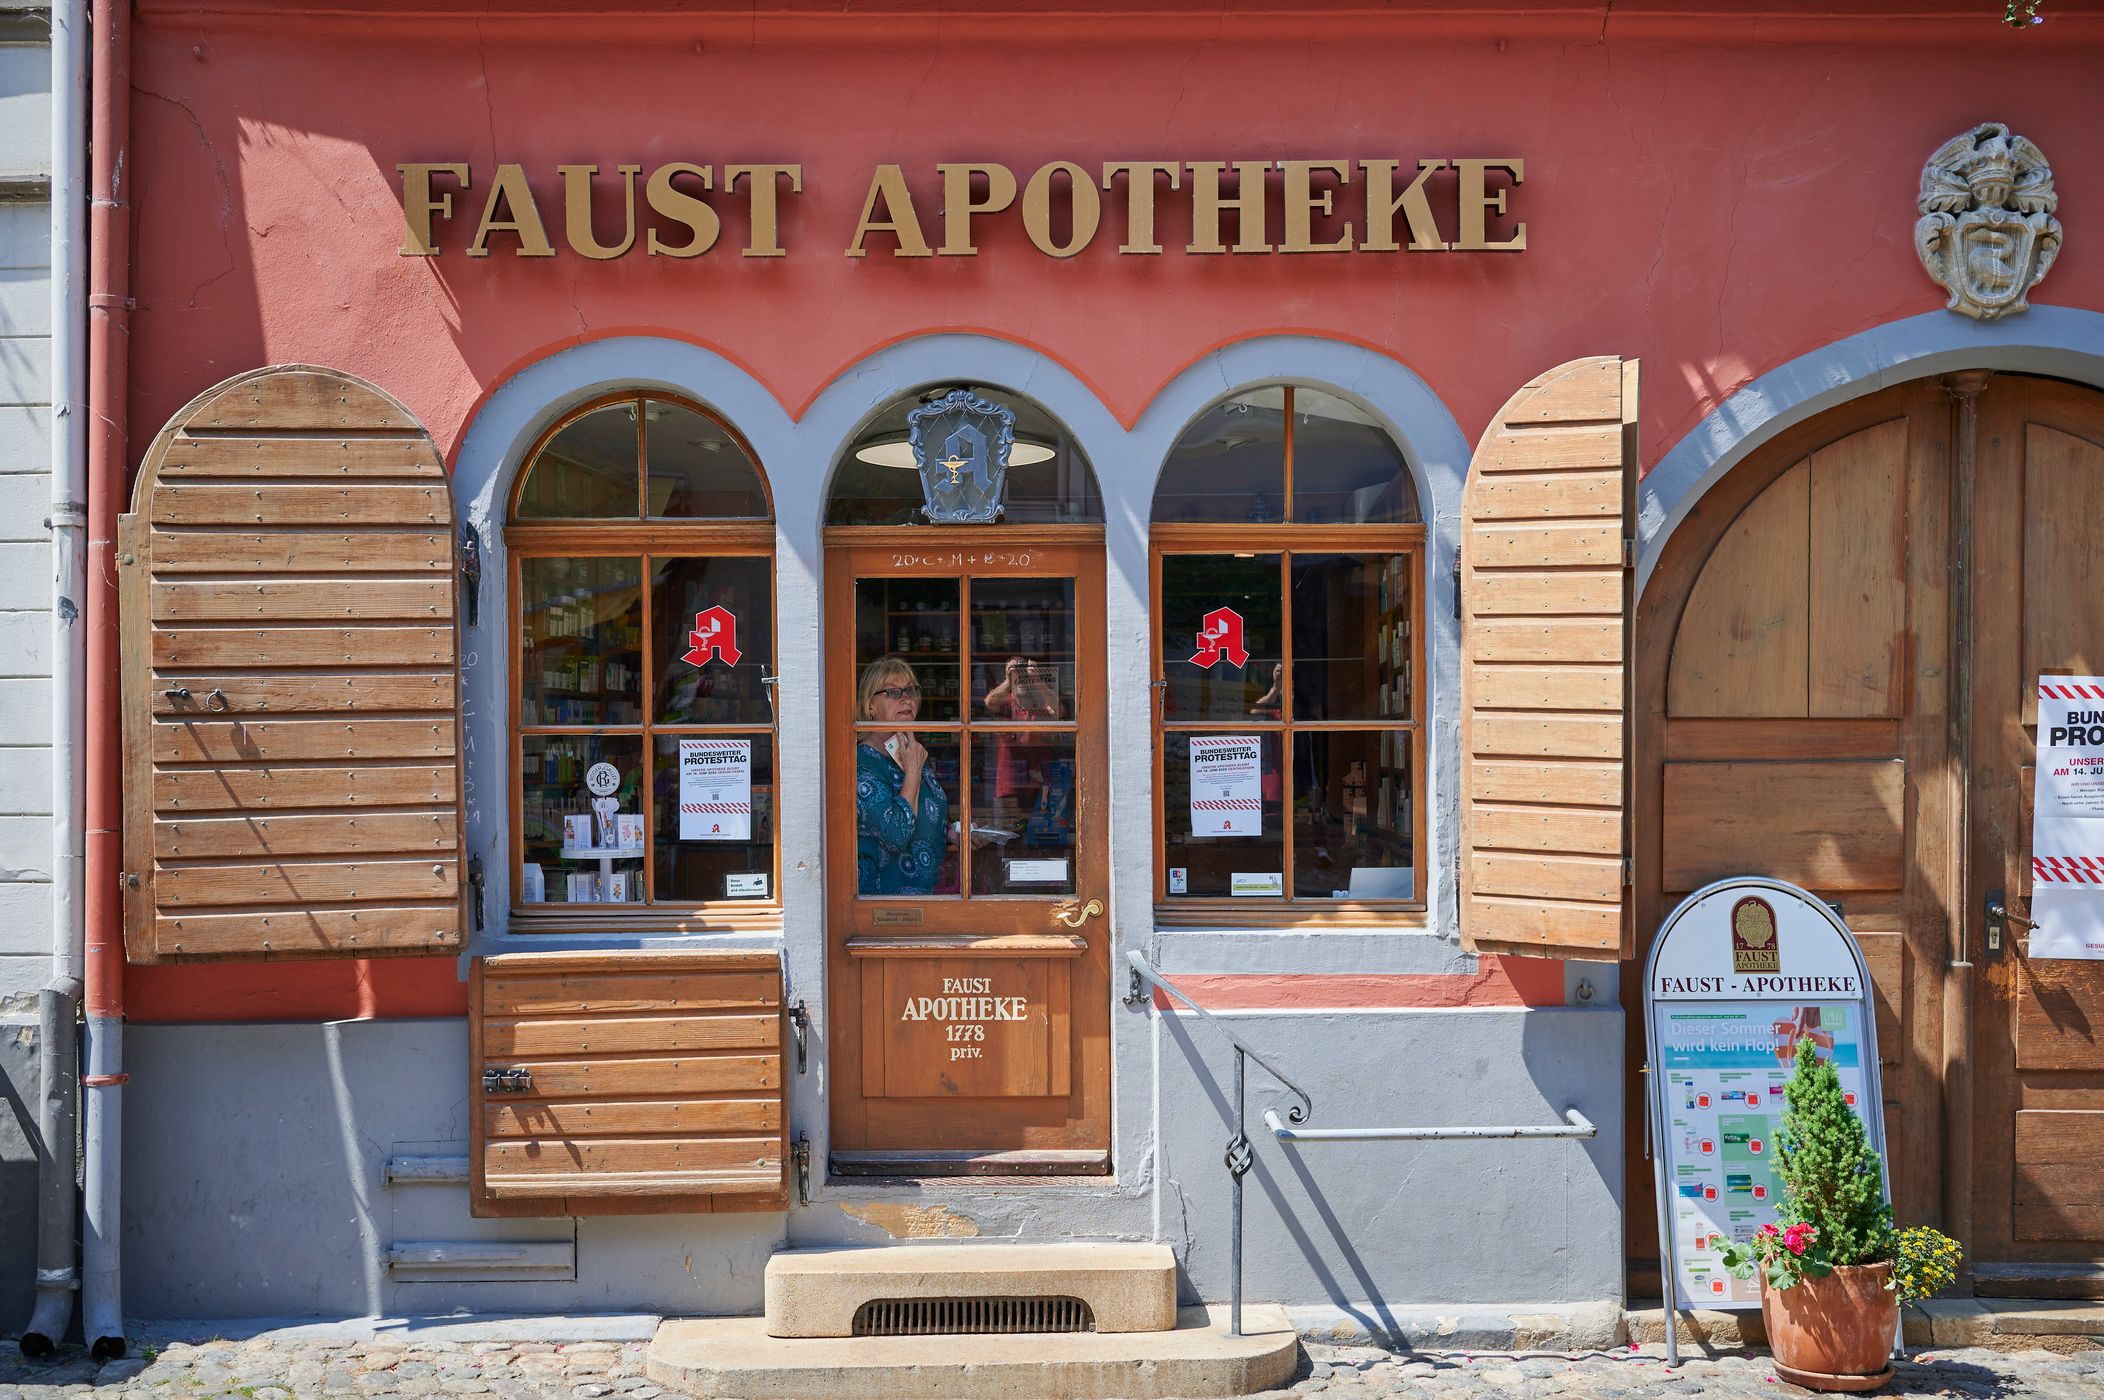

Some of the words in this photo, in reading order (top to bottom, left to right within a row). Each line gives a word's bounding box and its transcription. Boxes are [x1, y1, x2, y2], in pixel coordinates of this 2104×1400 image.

[396, 162, 802, 260] FAUST
[844, 159, 1527, 258] APOTHEKE
[2067, 711, 2104, 725] BUN
[2050, 726, 2104, 746] PRO
[1194, 752, 1257, 762] PROTESTTAG
[1200, 746, 1252, 755] BUNDESWEITER
[684, 755, 747, 765] PROTESTTAG
[2053, 768, 2069, 776] AM
[2073, 768, 2087, 776] 14.
[1735, 951, 1778, 962] FAUST
[943, 978, 992, 994] FAUST
[1661, 977, 1724, 992] FAUST
[1742, 976, 1856, 992] APOTHEKE
[901, 997, 1028, 1021] APOTHEKE
[945, 1024, 985, 1041] 1778
[1671, 1022, 1716, 1035] Dieser
[1721, 1022, 1781, 1035] Sommer
[950, 1044, 983, 1061] priv.
[1672, 1038, 1705, 1052] wird
[1710, 1039, 1740, 1052] kein
[1746, 1038, 1779, 1054] Flop!
